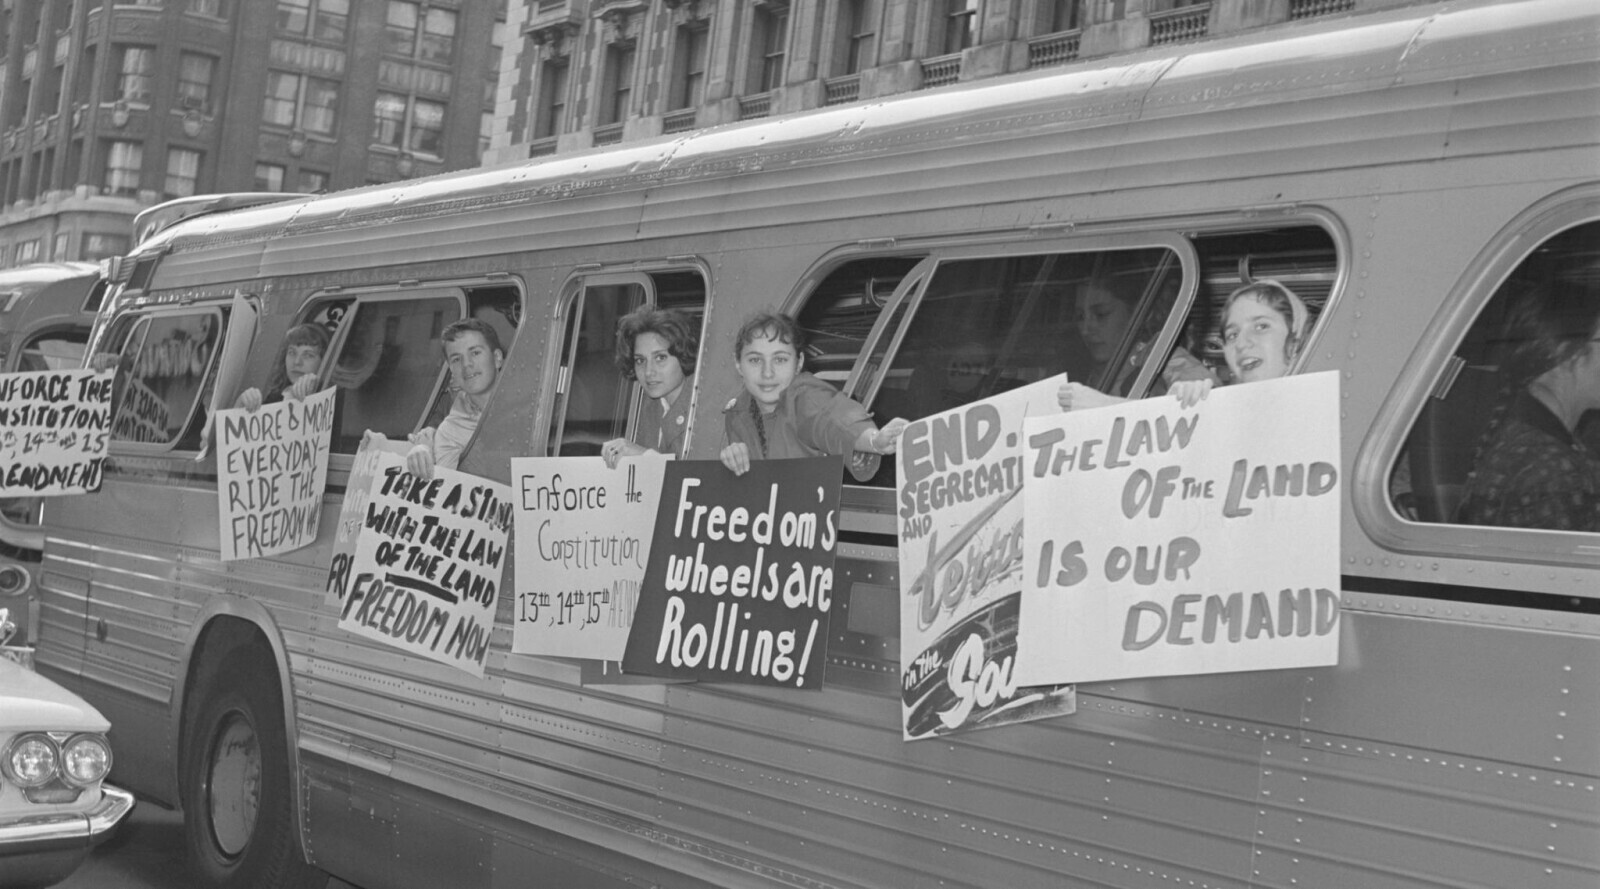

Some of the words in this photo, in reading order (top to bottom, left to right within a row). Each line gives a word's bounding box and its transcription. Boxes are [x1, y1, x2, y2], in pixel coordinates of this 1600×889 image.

[79, 375, 112, 403] THE
[225, 409, 282, 445] MORE
[303, 392, 336, 436] MORE
[1029, 427, 1103, 478] THE
[1103, 413, 1199, 469] LAW
[229, 472, 283, 513] RIDE
[290, 466, 317, 502] THE
[380, 465, 445, 510] TAKE
[442, 483, 462, 515] A
[522, 473, 606, 511] Enforce
[625, 464, 642, 503] the
[674, 477, 836, 552] Freedom's
[1121, 465, 1181, 519] OF
[1181, 477, 1214, 500] THE
[1222, 458, 1337, 518] LAND
[232, 505, 306, 558] FREEDOM
[365, 502, 418, 543] WITH
[419, 515, 461, 558] THE
[458, 529, 503, 569] LAW
[538, 518, 643, 570] Constitution
[901, 514, 932, 543] AND
[375, 541, 406, 567] OF
[404, 546, 444, 581] THE
[440, 562, 495, 609] LAND
[665, 542, 779, 601] wheels
[783, 561, 833, 612] are
[1037, 539, 1088, 588] IS
[1104, 536, 1201, 585] OUR
[340, 573, 450, 651] FREEDOM
[444, 615, 491, 667] NOW
[656, 595, 819, 687] Rolling!
[1122, 588, 1340, 652] DEMAND
